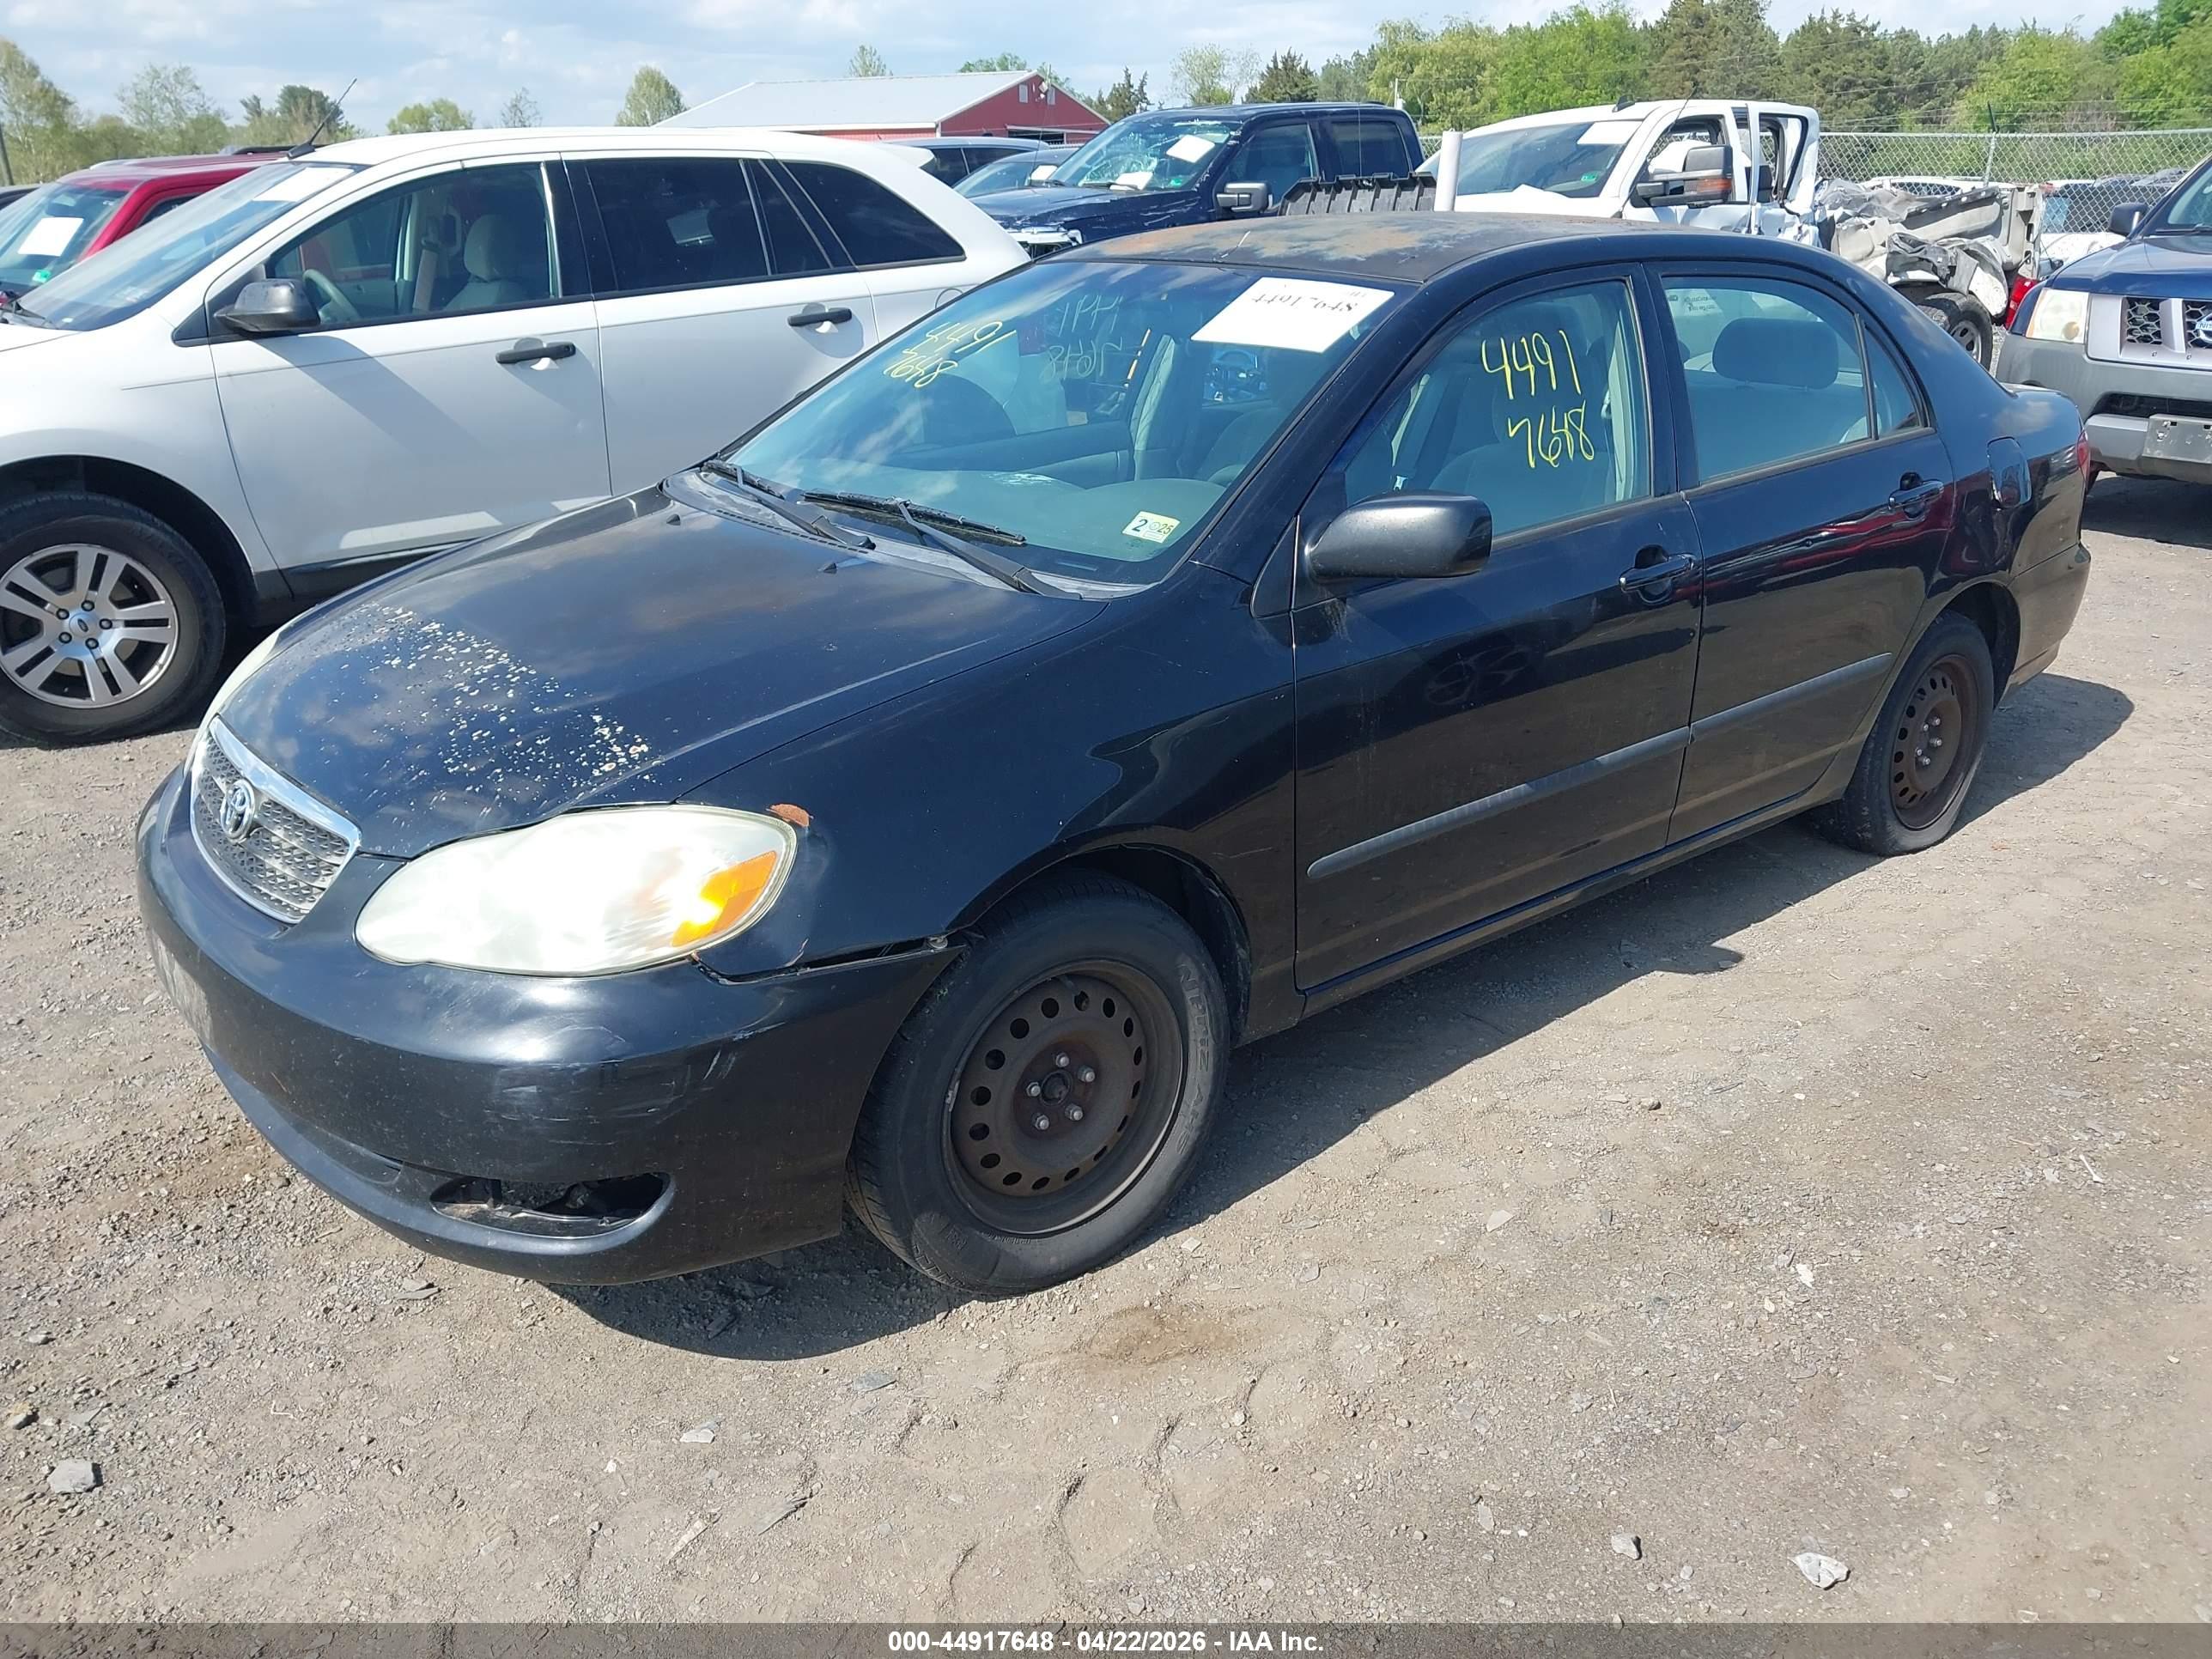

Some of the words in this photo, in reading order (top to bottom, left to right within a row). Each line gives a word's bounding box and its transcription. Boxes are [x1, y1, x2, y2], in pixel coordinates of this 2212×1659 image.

[884, 348, 958, 387] 7648
[1481, 330, 1582, 399] 4491
[1507, 398, 1595, 469] 7648
[1132, 519, 1148, 532] 2
[1157, 523, 1174, 535] 25
